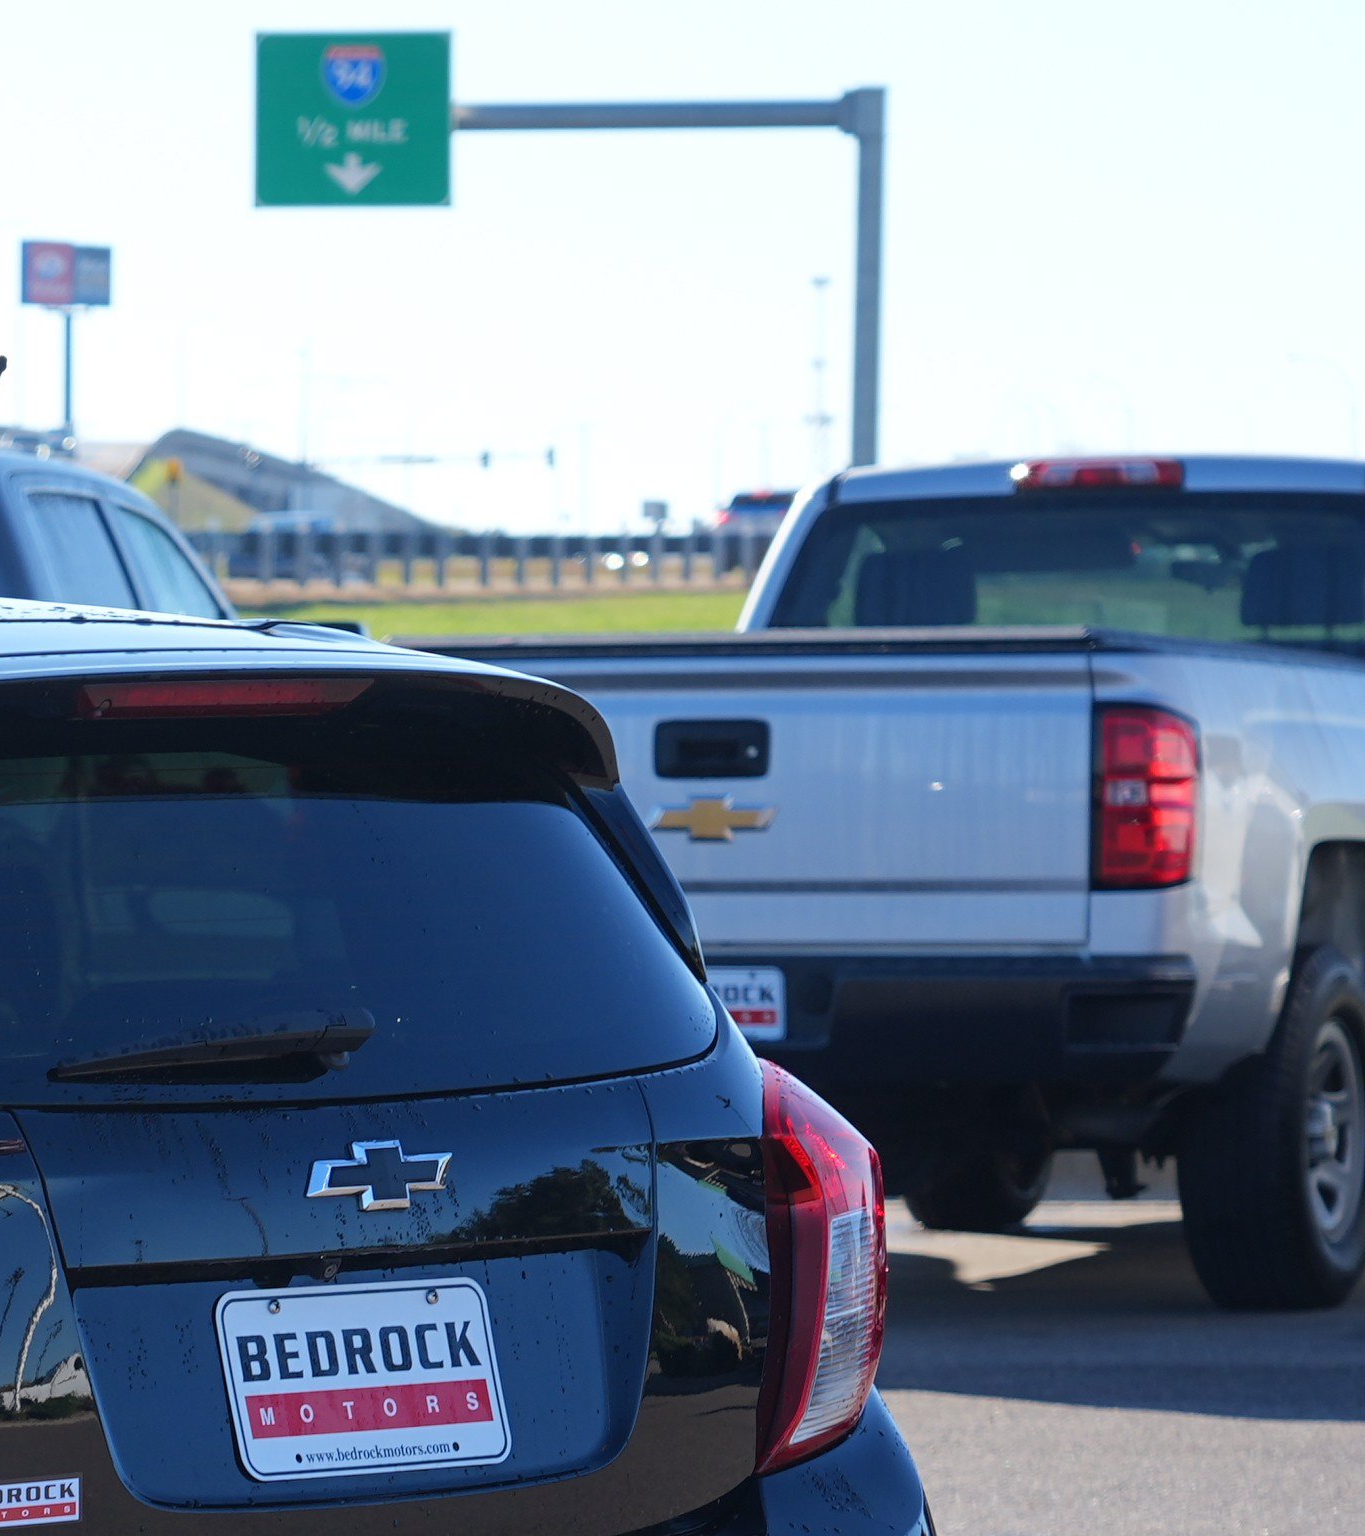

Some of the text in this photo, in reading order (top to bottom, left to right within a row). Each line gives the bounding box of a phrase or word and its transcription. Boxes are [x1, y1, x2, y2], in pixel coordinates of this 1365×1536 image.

[332, 59, 375, 91] 94
[346, 117, 409, 145] MILE
[235, 1320, 482, 1383] BEDROCK
[259, 1392, 480, 1427] MOTORS
[305, 1441, 451, 1465] www.bedrockmotors.com
